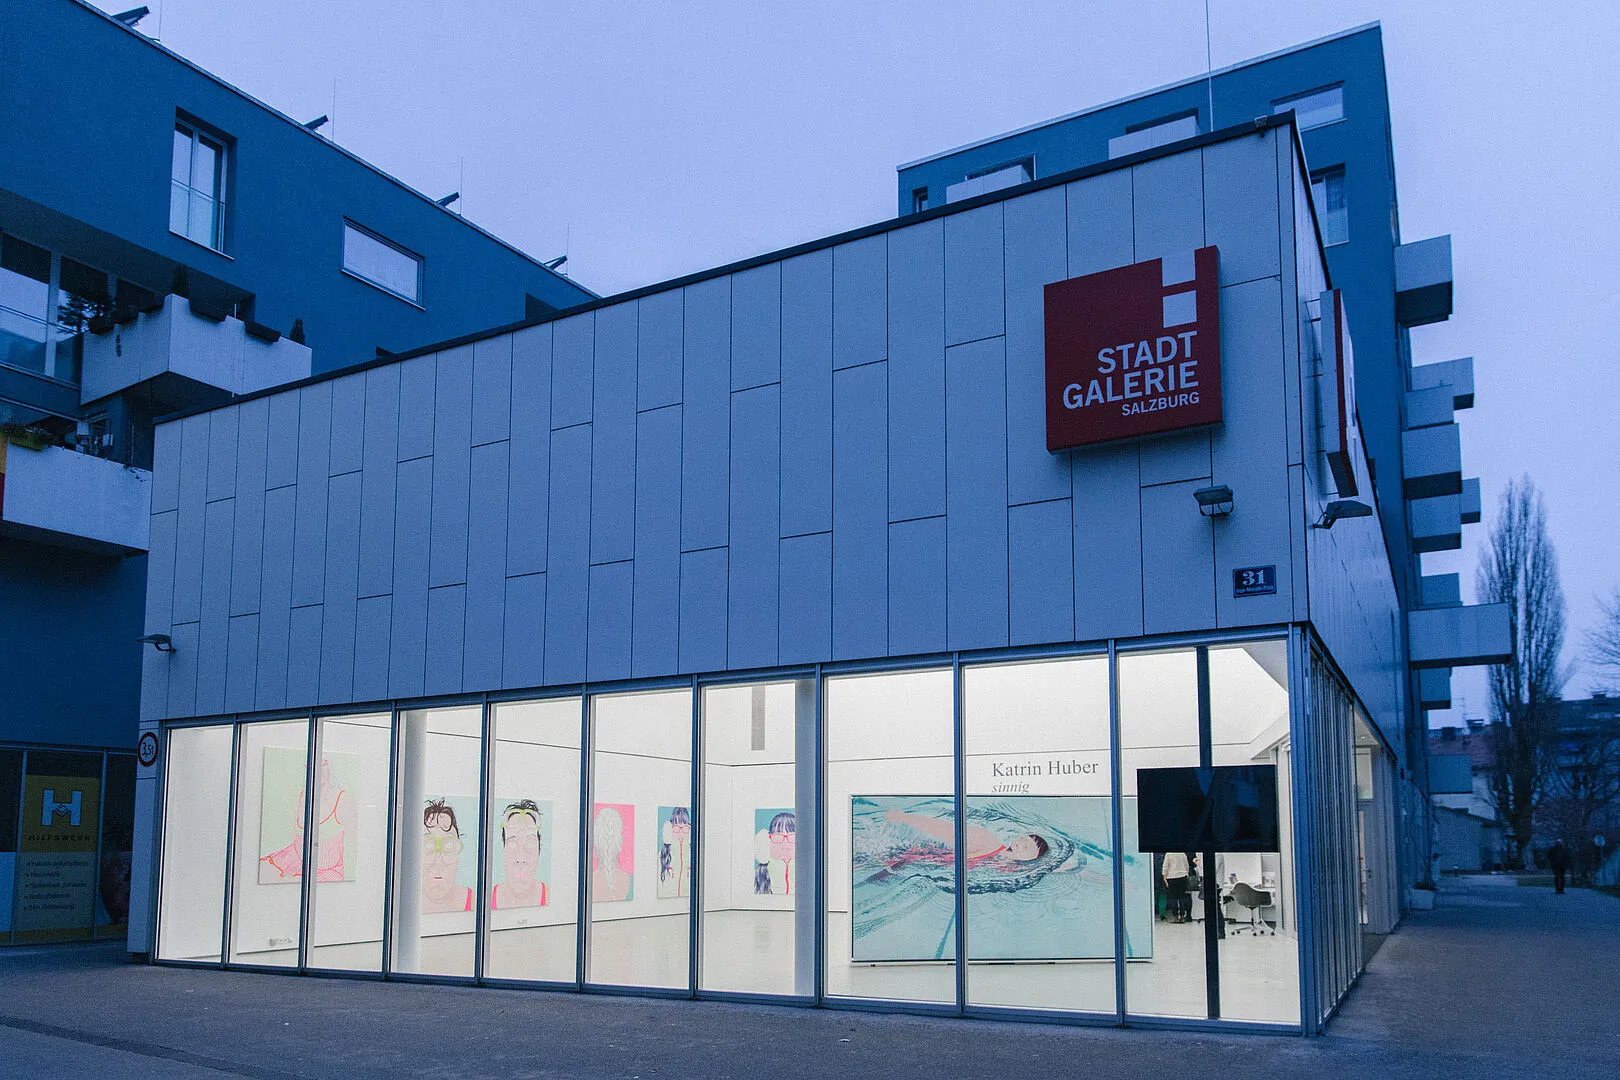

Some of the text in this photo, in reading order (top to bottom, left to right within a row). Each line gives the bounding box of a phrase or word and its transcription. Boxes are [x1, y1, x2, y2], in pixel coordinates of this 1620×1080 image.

[1097, 330, 1198, 374] STADT
[1063, 360, 1199, 410] GALERIE
[1122, 391, 1200, 416] SALZBURG
[1242, 569, 1265, 586] 31
[992, 759, 1099, 777] Katrin Huber
[991, 780, 1030, 794] sinnig
[28, 834, 90, 842] HILFSWERK
